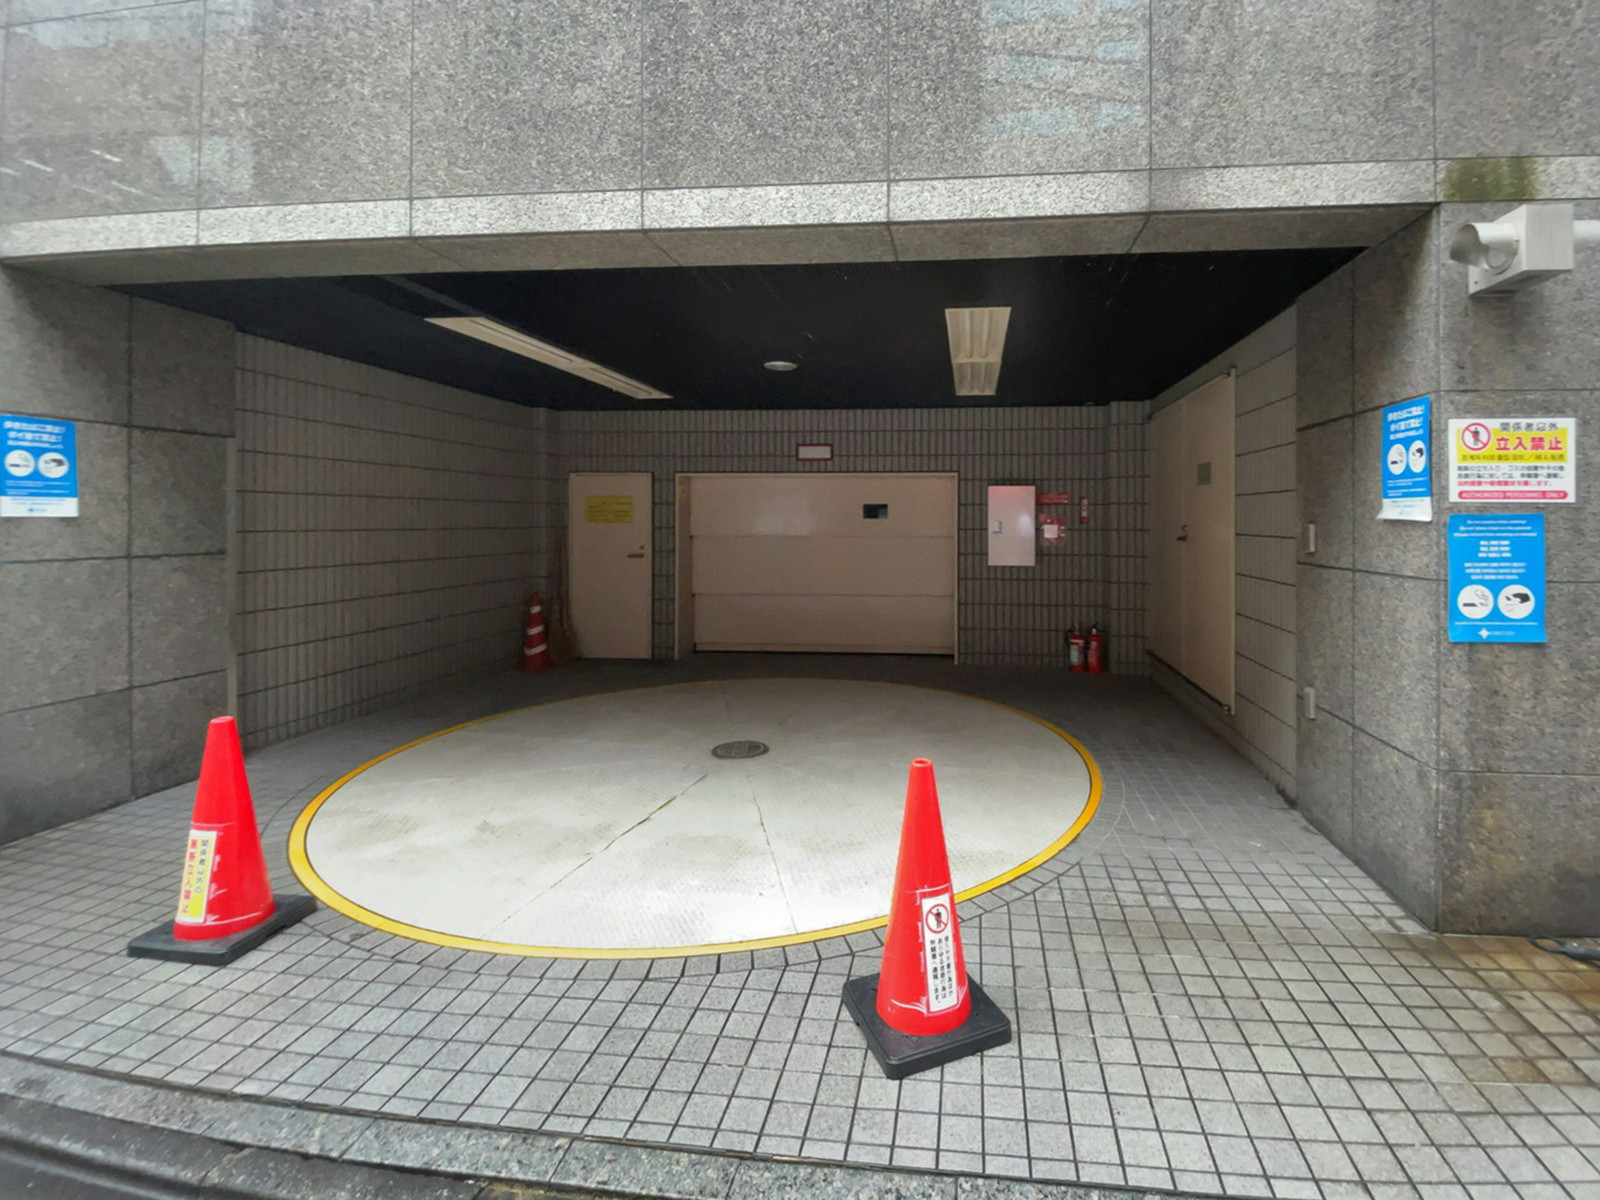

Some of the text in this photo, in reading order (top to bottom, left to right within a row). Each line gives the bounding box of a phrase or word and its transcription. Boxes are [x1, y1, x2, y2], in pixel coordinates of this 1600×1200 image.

[1500, 422, 1558, 432] 関係者以外
[1496, 436, 1563, 451] 立入禁止
